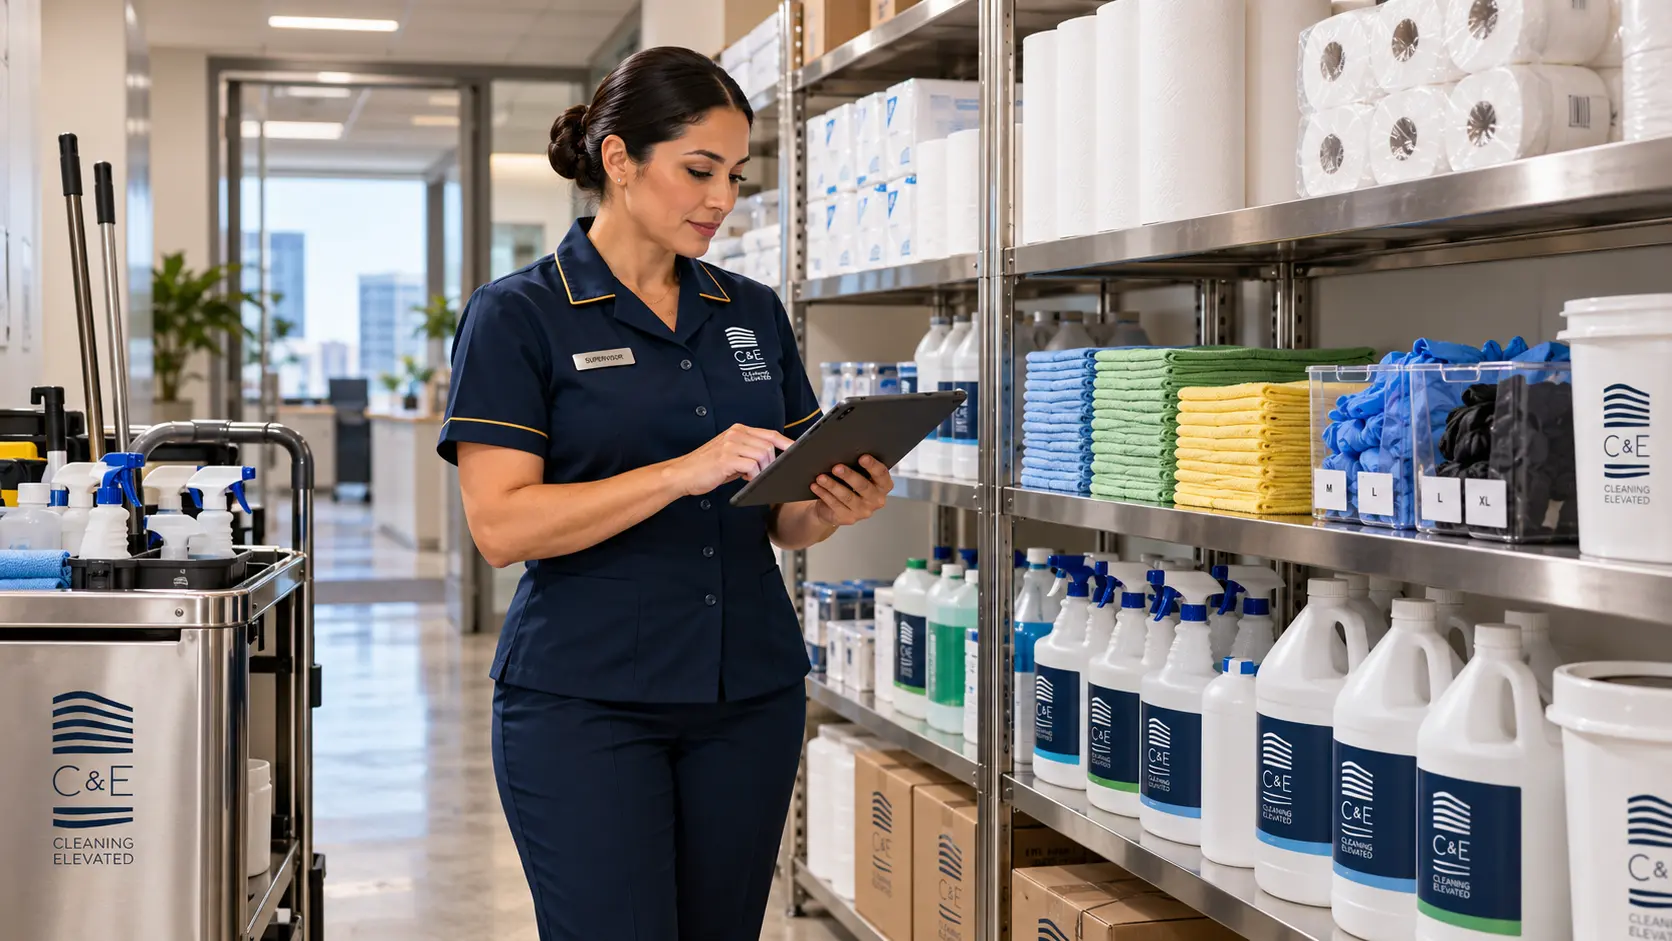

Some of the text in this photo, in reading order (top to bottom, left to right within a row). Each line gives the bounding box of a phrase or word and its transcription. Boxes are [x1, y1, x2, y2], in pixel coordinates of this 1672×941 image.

[733, 349, 764, 363] C&E
[1603, 434, 1651, 458] C&E
[1326, 484, 1333, 493] M
[1372, 487, 1377, 497] L
[1604, 484, 1651, 495] CLEANING
[1438, 493, 1443, 503] L
[1479, 495, 1491, 507] XL
[1604, 495, 1651, 505] ELEVATED
[1148, 747, 1171, 767] C&E
[53, 765, 134, 797] C&E
[1262, 769, 1292, 793] C&E
[1341, 800, 1373, 825] C&E
[53, 837, 134, 849] CLEANING
[1432, 834, 1471, 862] C&E
[53, 853, 134, 865] ELEVATED
[1433, 874, 1471, 891] CLEANING
[1433, 882, 1471, 899] ELEVATED
